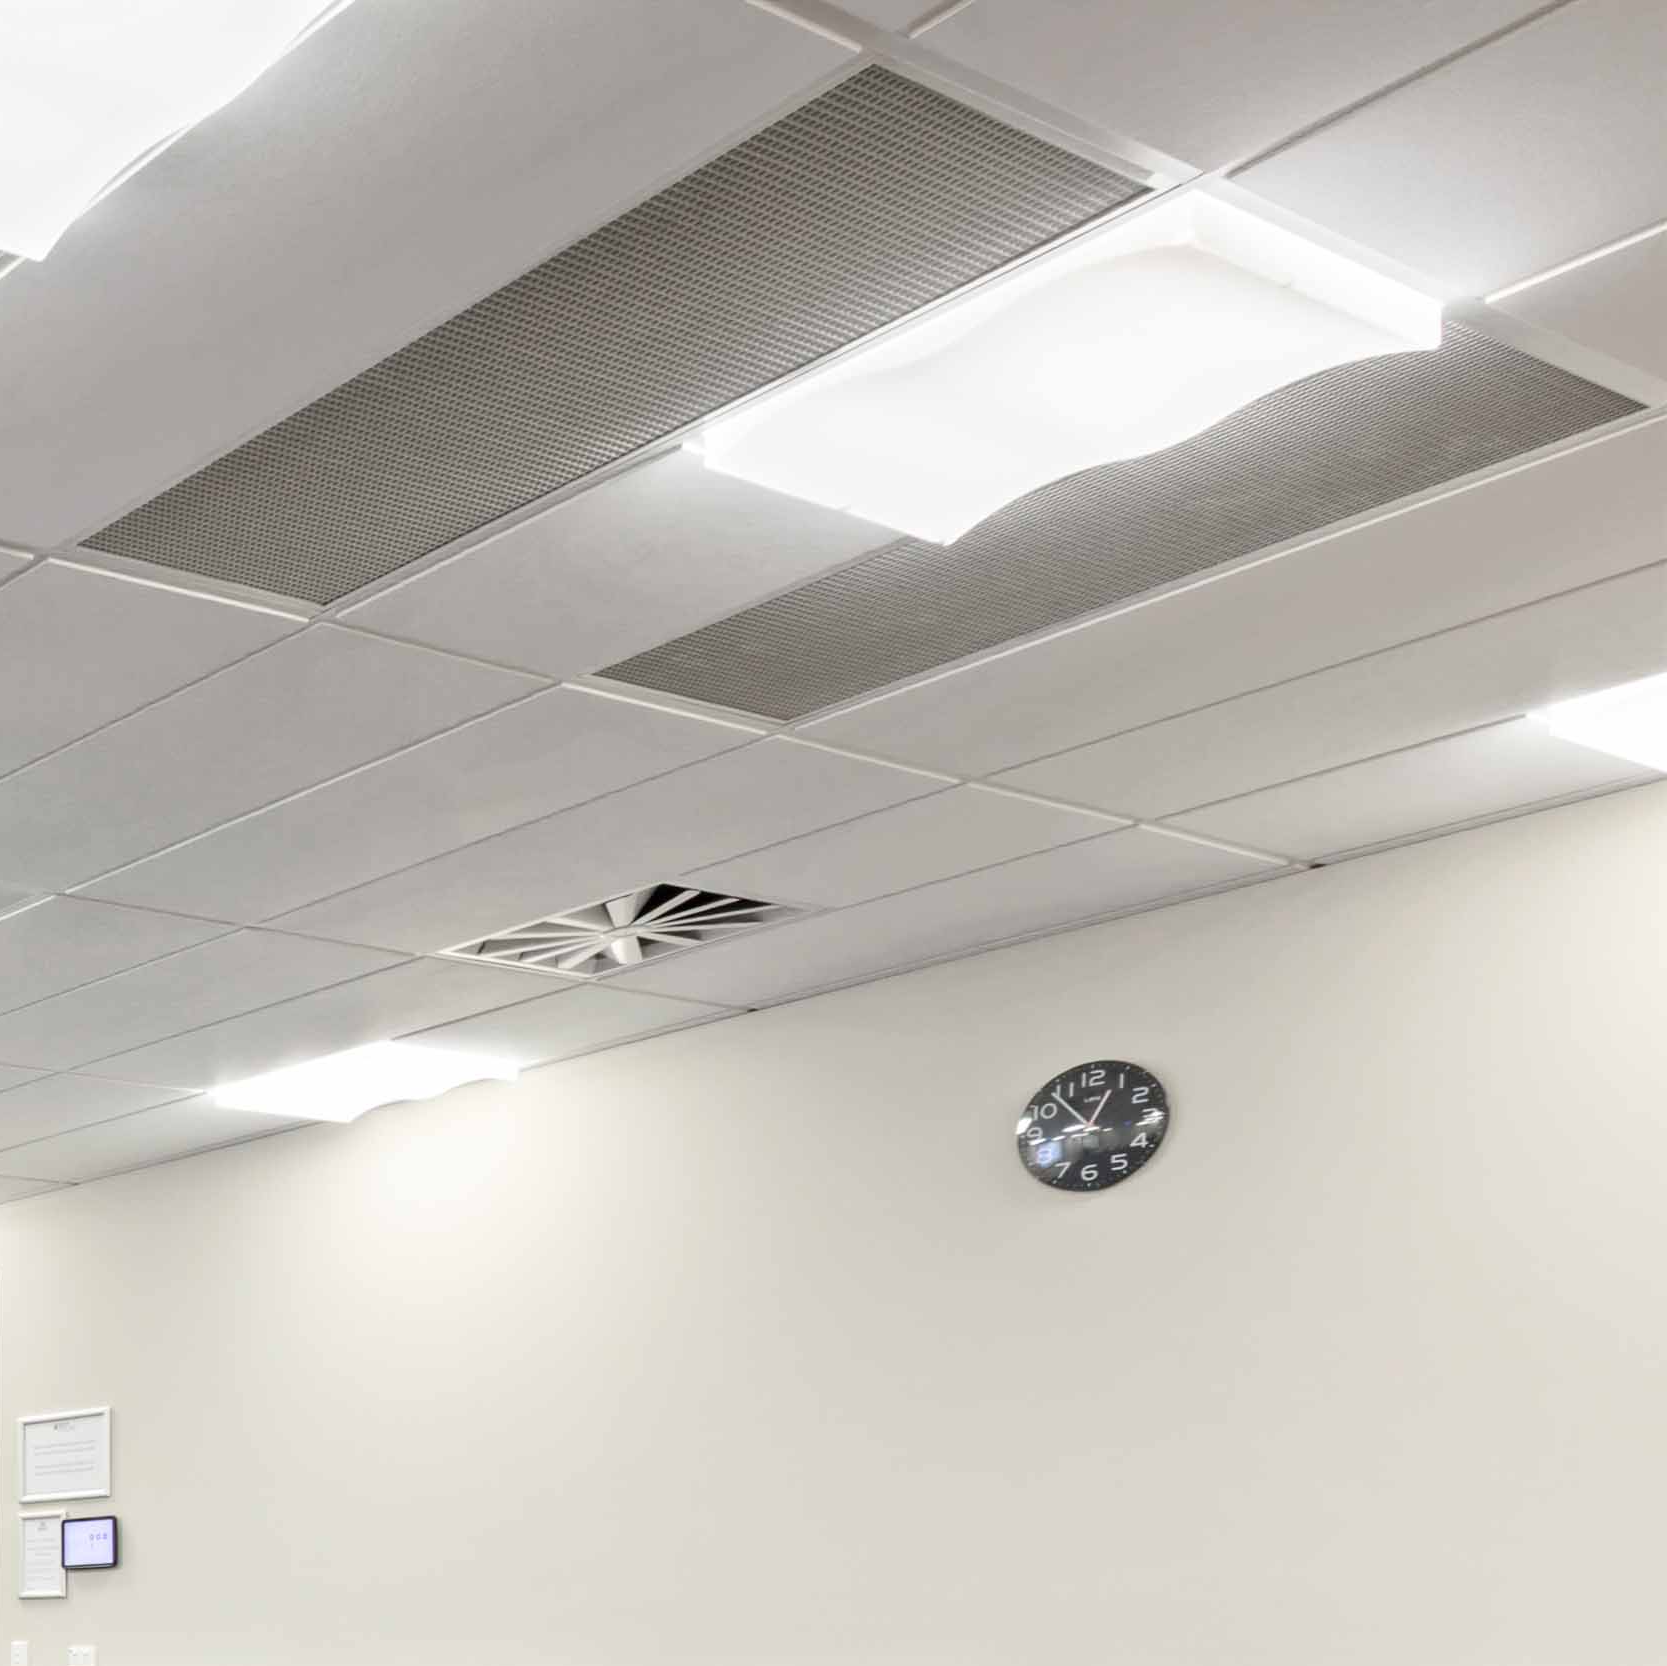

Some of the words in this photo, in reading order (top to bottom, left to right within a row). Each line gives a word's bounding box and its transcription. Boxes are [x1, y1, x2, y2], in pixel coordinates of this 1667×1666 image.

[1081, 1069, 1106, 1088] 12
[1131, 1086, 1149, 1104] 2
[1030, 1103, 1058, 1121] 10
[1129, 1132, 1149, 1148] 4
[1055, 1161, 1071, 1179] 7
[1109, 1153, 1128, 1171] 5
[1081, 1163, 1098, 1181] 6
